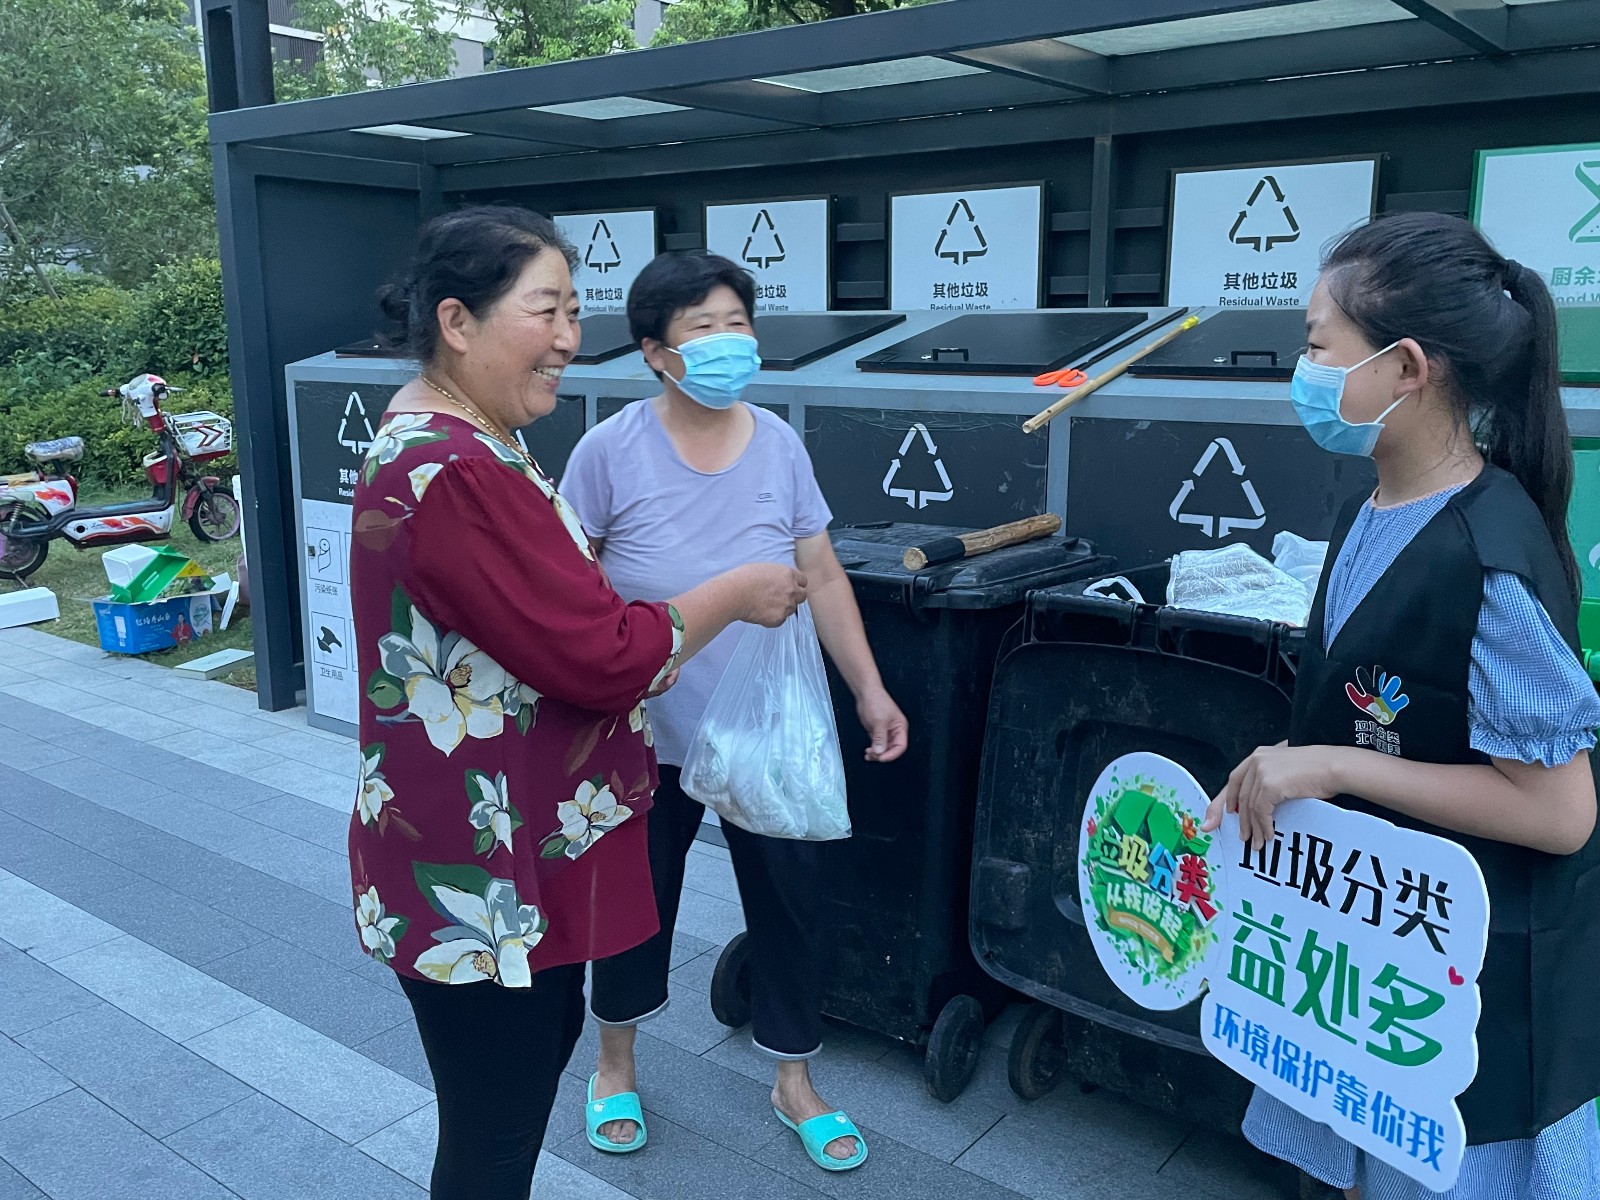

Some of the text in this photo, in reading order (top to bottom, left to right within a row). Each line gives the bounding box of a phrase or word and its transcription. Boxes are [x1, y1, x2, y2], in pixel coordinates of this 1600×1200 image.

[1223, 271, 1298, 290] 其他垃圾
[1551, 266, 1600, 286] 厨余
[585, 287, 623, 300] 其他垃圾
[754, 284, 787, 298] 他垃圾
[933, 282, 988, 298] 其他垃圾
[584, 304, 607, 312] Residual
[767, 303, 789, 311] Waste
[1219, 296, 1299, 306] Residual Waste
[339, 468, 362, 485] 其他
[320, 667, 344, 681] 卫生用品
[1088, 824, 1217, 921] 垃圾分类
[1227, 899, 1445, 1067] 益处多
[1212, 1003, 1445, 1173] 环境保护靠你我
